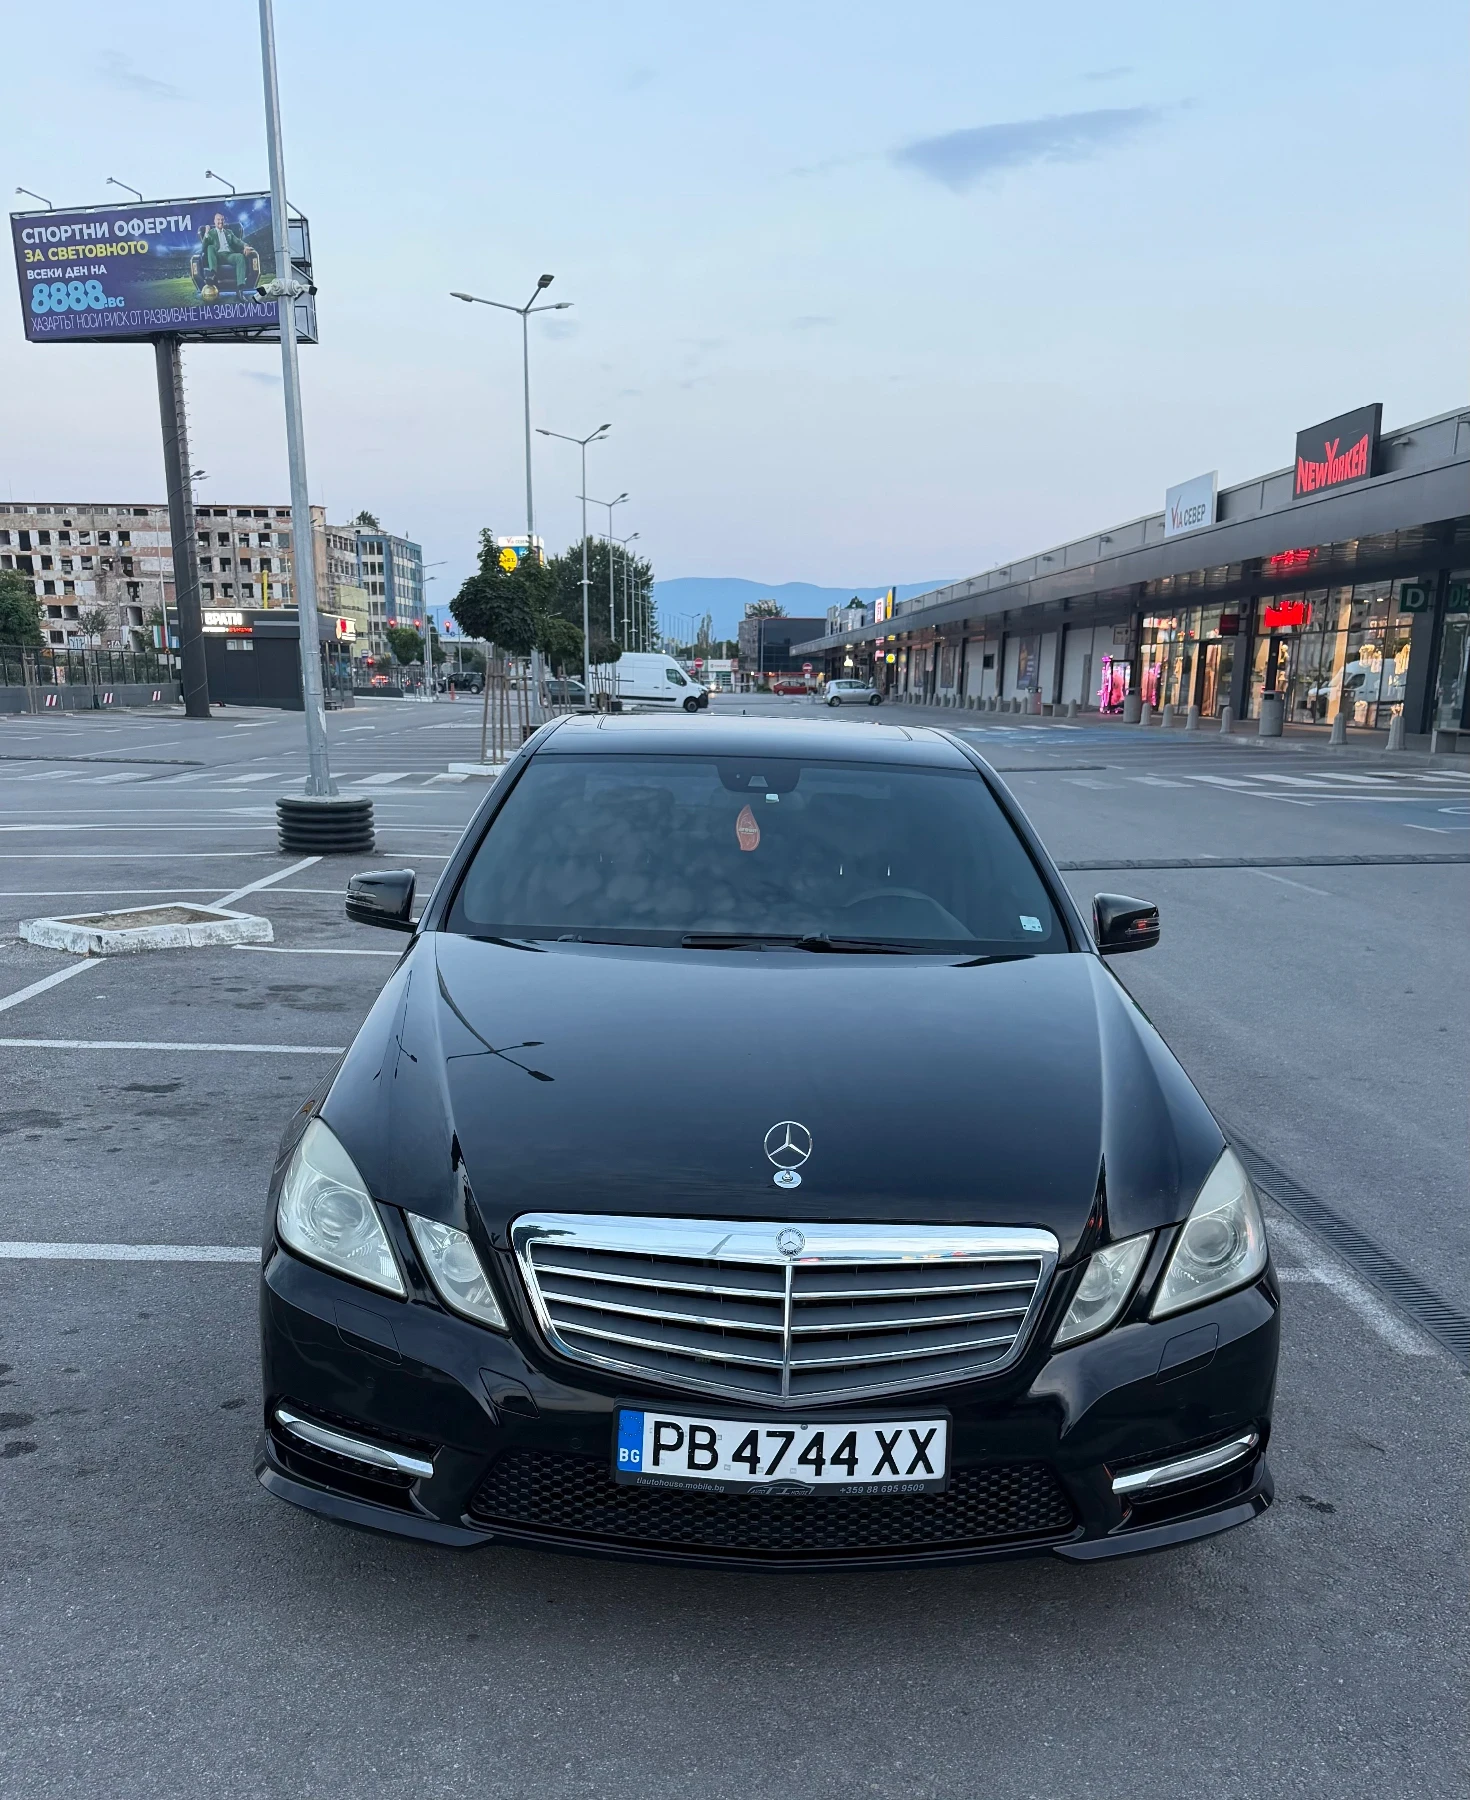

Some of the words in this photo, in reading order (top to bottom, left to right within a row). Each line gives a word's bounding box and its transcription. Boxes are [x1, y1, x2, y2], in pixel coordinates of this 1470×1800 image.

[22, 222, 110, 244] СПОРТНИ
[114, 215, 192, 237] ОФЕРТИ
[24, 249, 45, 263] ЗА
[48, 240, 149, 261] СВЕТОВНОТО
[27, 268, 63, 280] ВСЕКИ
[65, 266, 88, 278] ДЕН
[90, 264, 107, 275] НА
[31, 314, 75, 332] ХАЗАРТЪТ
[77, 312, 102, 329] НОСИ
[104, 311, 129, 326] РИСК
[130, 310, 142, 325] ОТ
[144, 307, 199, 325] РАЗВИВАНЕ
[199, 305, 212, 321] НА
[213, 301, 277, 320] ЗАВИСИМОСТ
[1406, 588, 1425, 608] D
[619, 1448, 640, 1463] BG
[652, 1420, 720, 1471] PB
[731, 1429, 859, 1477] 4744
[871, 1428, 938, 1476] XX
[840, 1486, 864, 1495] +359
[866, 1485, 879, 1494] 88
[881, 1484, 899, 1493] 695
[901, 1483, 925, 1492] 9509
